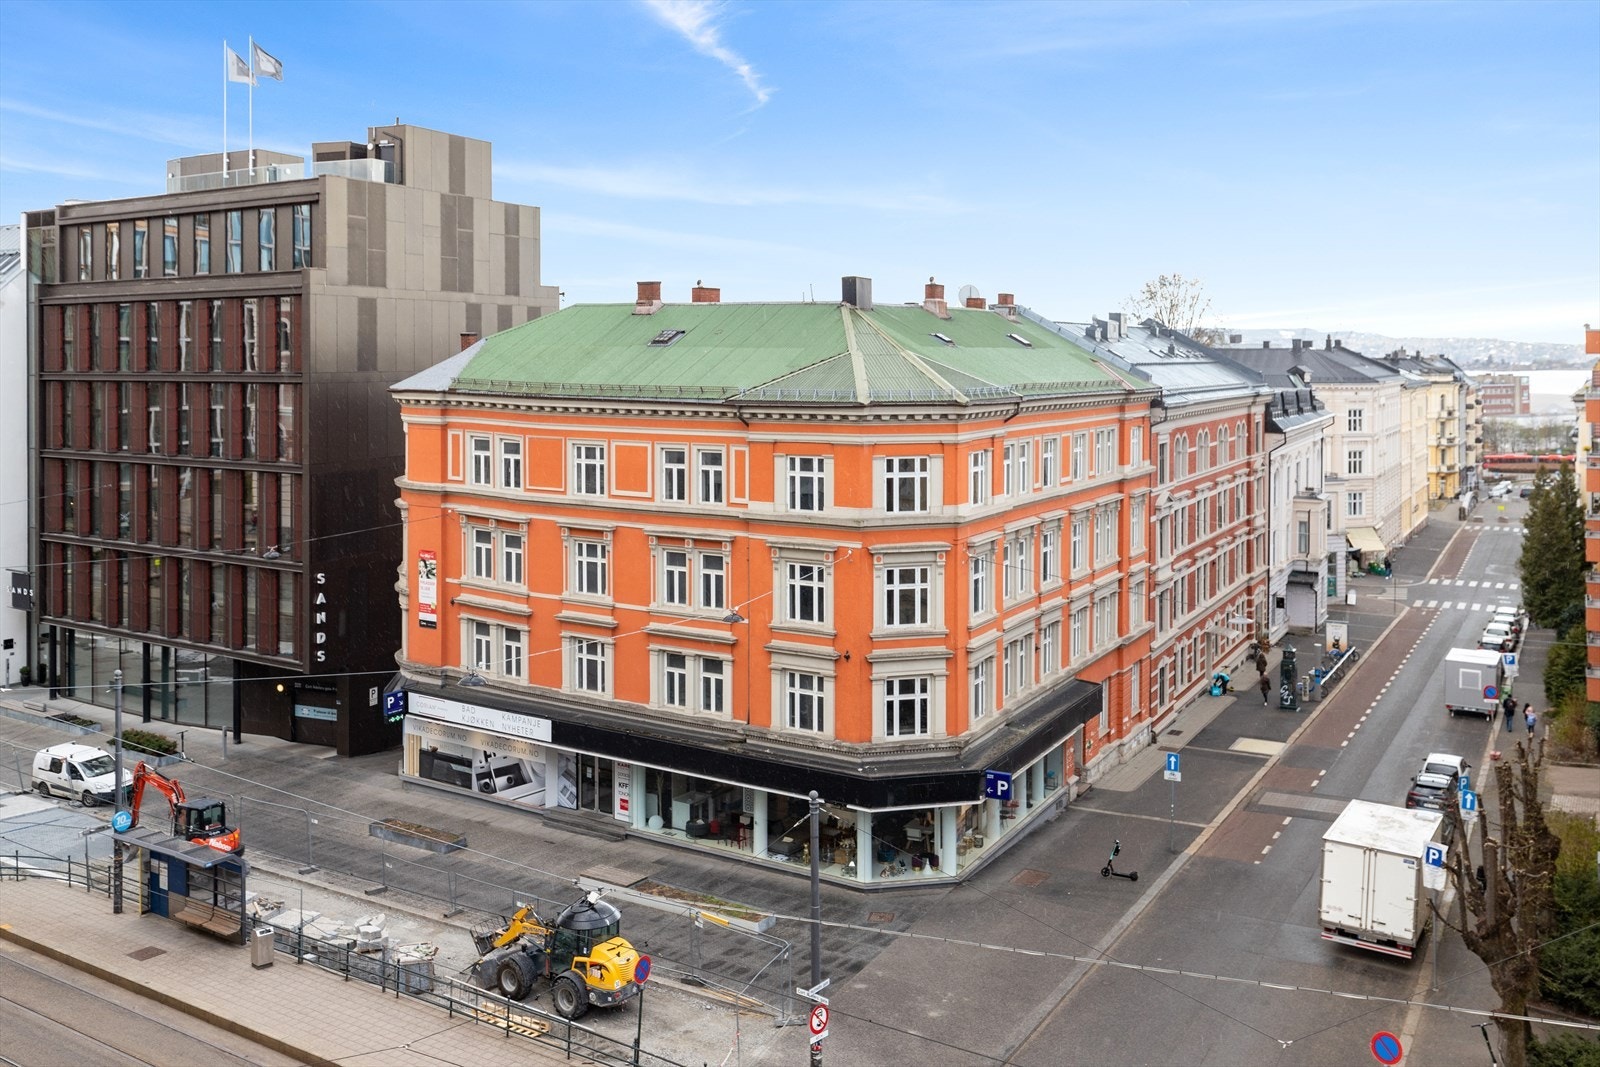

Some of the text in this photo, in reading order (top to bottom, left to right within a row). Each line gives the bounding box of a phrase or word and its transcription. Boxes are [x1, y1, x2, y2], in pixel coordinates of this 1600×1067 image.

[316, 572, 327, 662] SANDS
[1506, 655, 1513, 664] P
[371, 689, 376, 698] P
[387, 696, 395, 709] P
[462, 705, 476, 714] BAD
[462, 715, 494, 728] KJØKKEN
[502, 713, 541, 728] KAMPANJE
[412, 724, 467, 742] VIKADECORUM.NO
[502, 723, 534, 736] NYHETER
[481, 740, 539, 758] VIKADECORUM.NO
[997, 780, 1008, 796] P
[1460, 778, 1468, 790] P
[116, 815, 126, 823] 10
[1429, 848, 1440, 864] P
